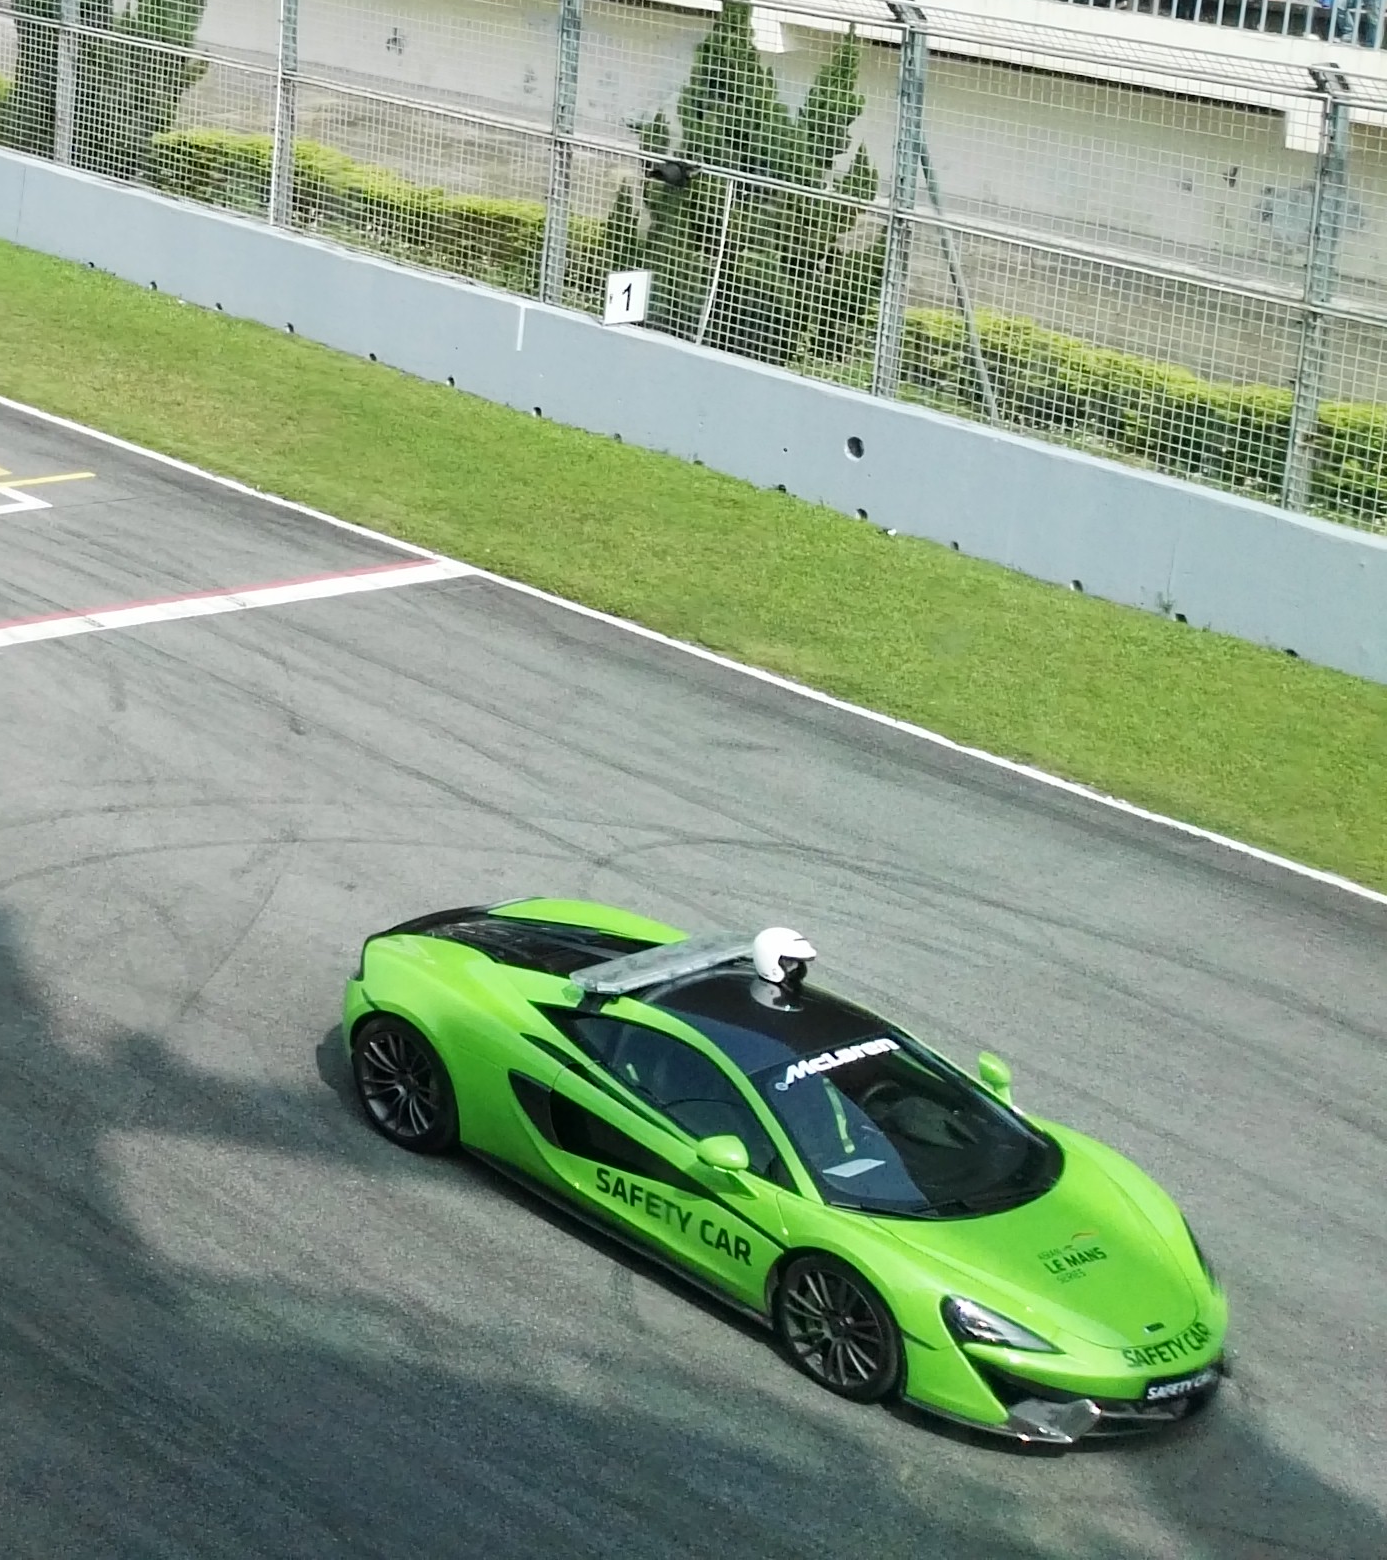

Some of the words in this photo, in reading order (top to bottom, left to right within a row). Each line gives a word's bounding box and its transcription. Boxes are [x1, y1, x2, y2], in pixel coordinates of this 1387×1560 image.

[622, 283, 632, 311] 1
[785, 1038, 900, 1085] McLaren
[596, 1167, 693, 1233] SAFETY
[699, 1219, 752, 1267] CAR
[1043, 1258, 1064, 1275] LE
[1064, 1246, 1107, 1268] MANS
[1122, 1338, 1188, 1368] SAFETY
[1183, 1321, 1213, 1351] CAR
